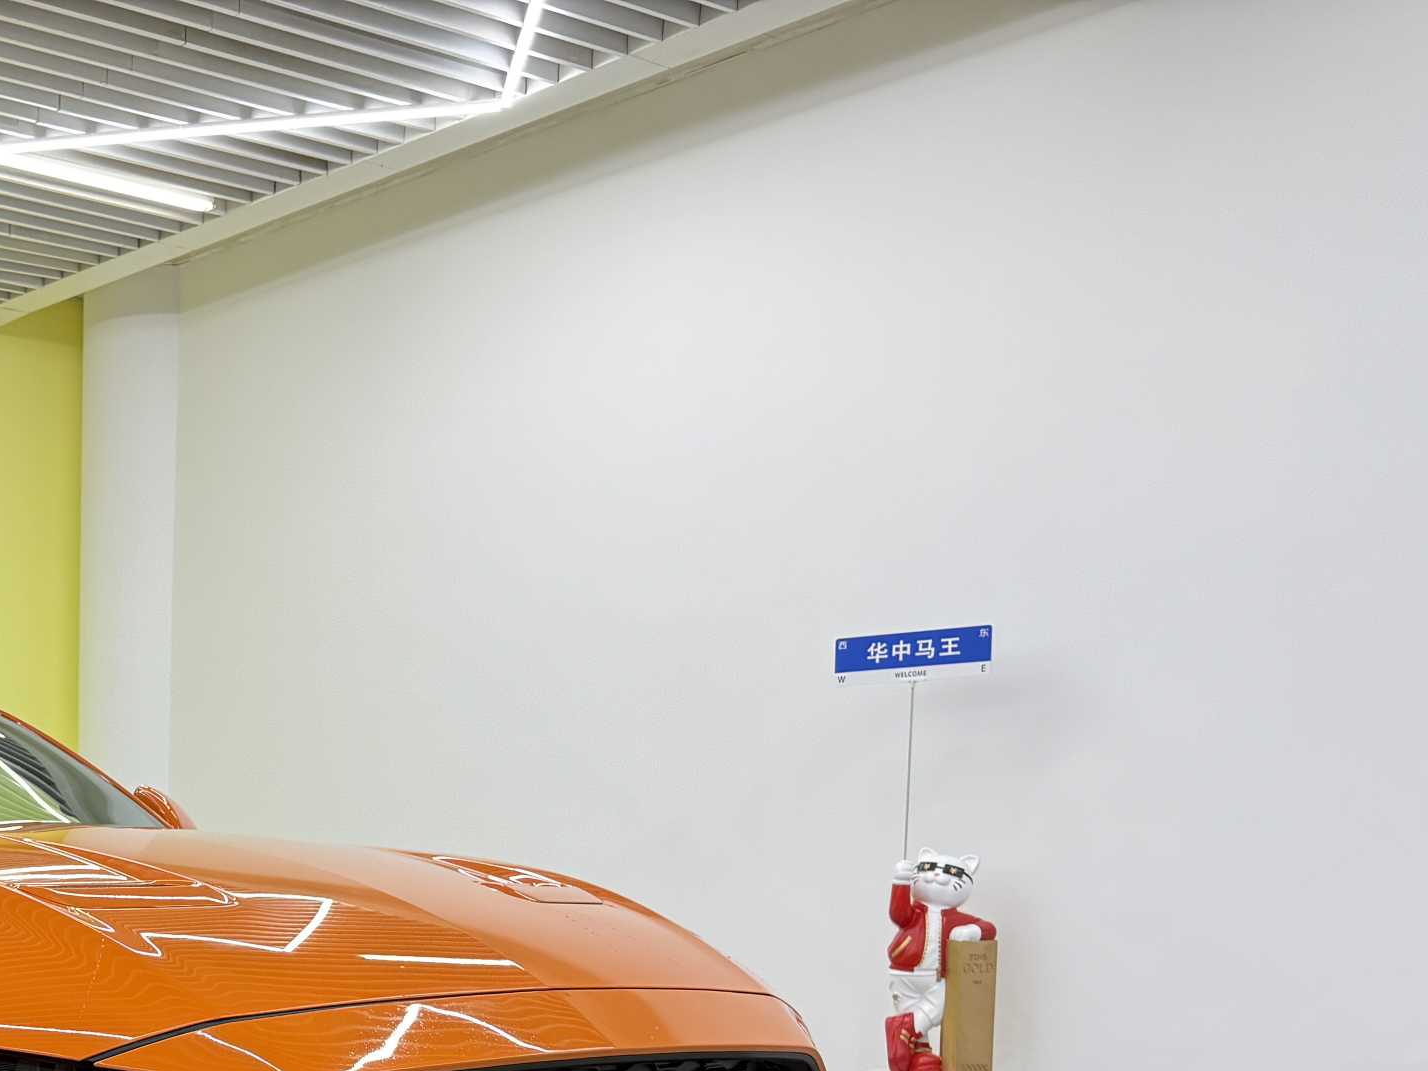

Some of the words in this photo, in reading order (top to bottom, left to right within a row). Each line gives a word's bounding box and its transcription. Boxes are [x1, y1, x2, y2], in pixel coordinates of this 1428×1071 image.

[866, 637, 961, 664] 华中马王
[894, 670, 927, 679] WELCOME
[837, 675, 846, 684] W
